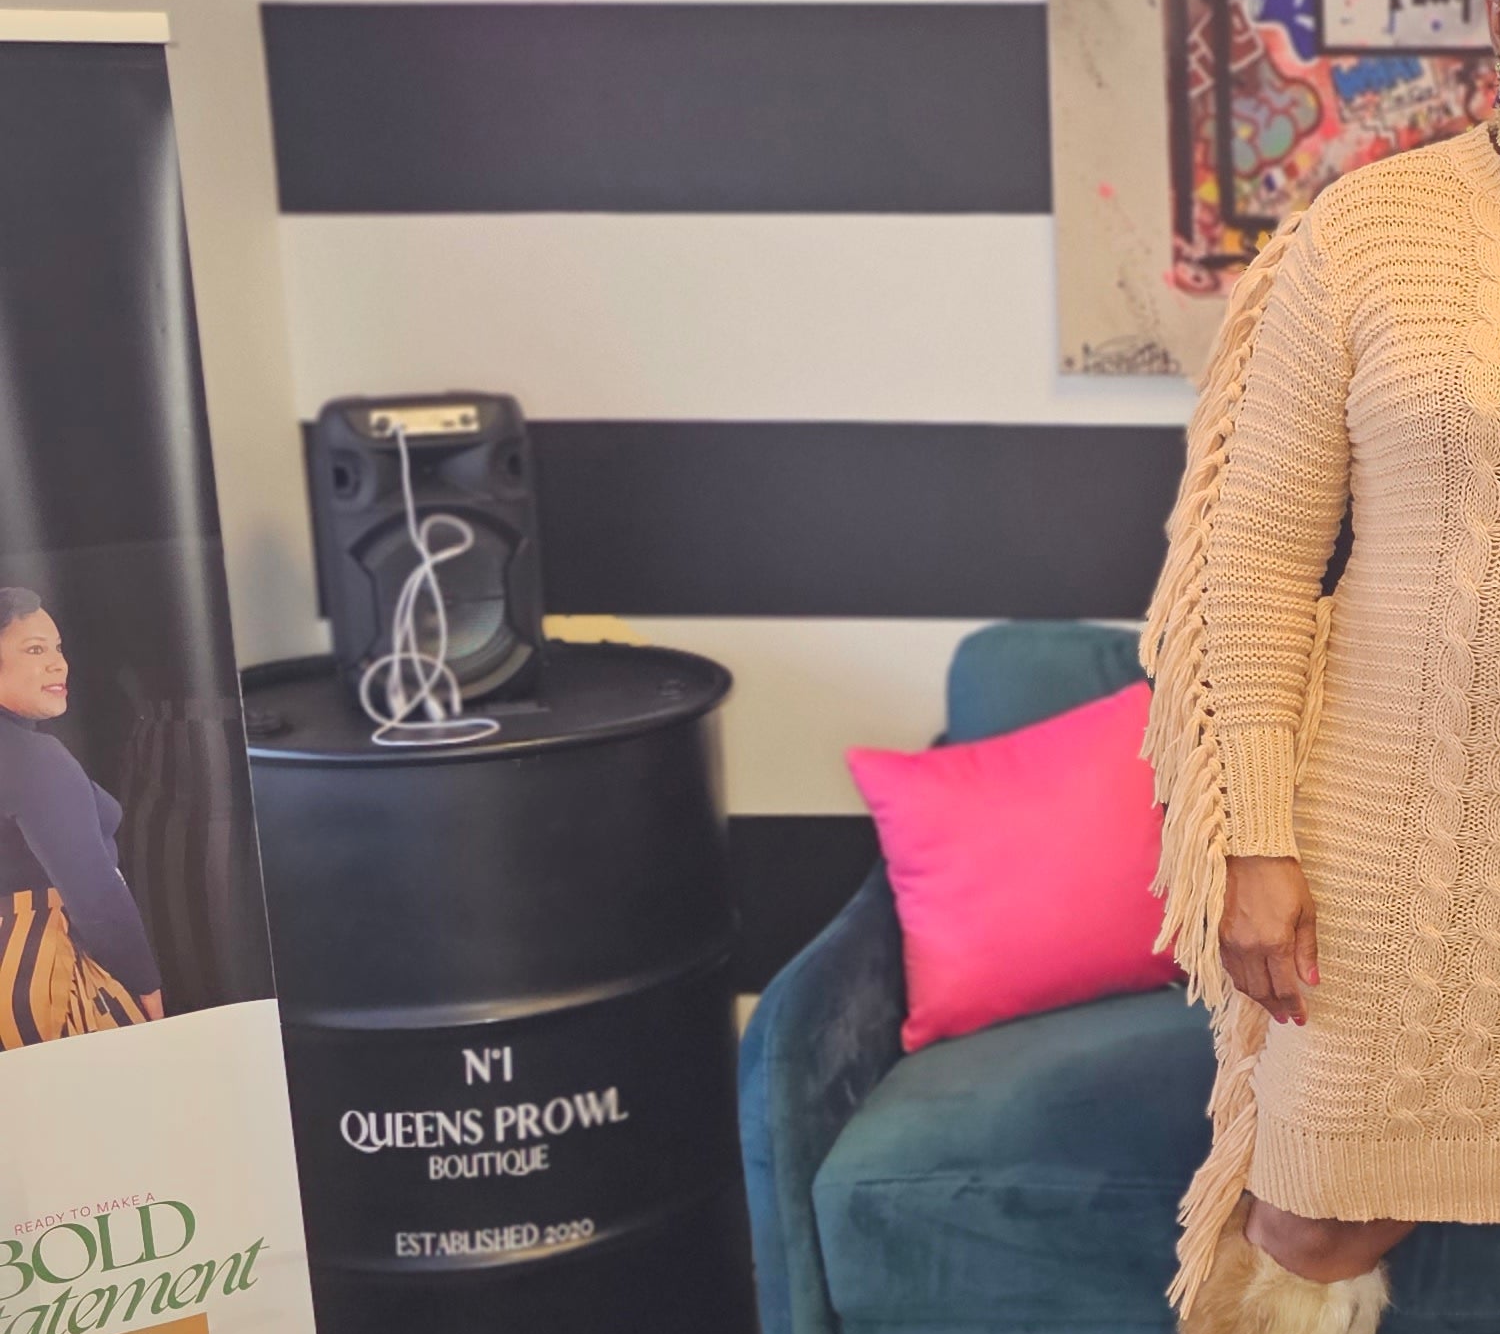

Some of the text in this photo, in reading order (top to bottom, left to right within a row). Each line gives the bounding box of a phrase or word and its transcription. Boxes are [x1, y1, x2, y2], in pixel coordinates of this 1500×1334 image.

[340, 1086, 629, 1153] QUEENS PROWL
[428, 1144, 549, 1180] BOUTIQUE
[14, 1192, 156, 1236] READY TO MAKE A
[396, 1218, 594, 1257] ESTABLISHED 2020
